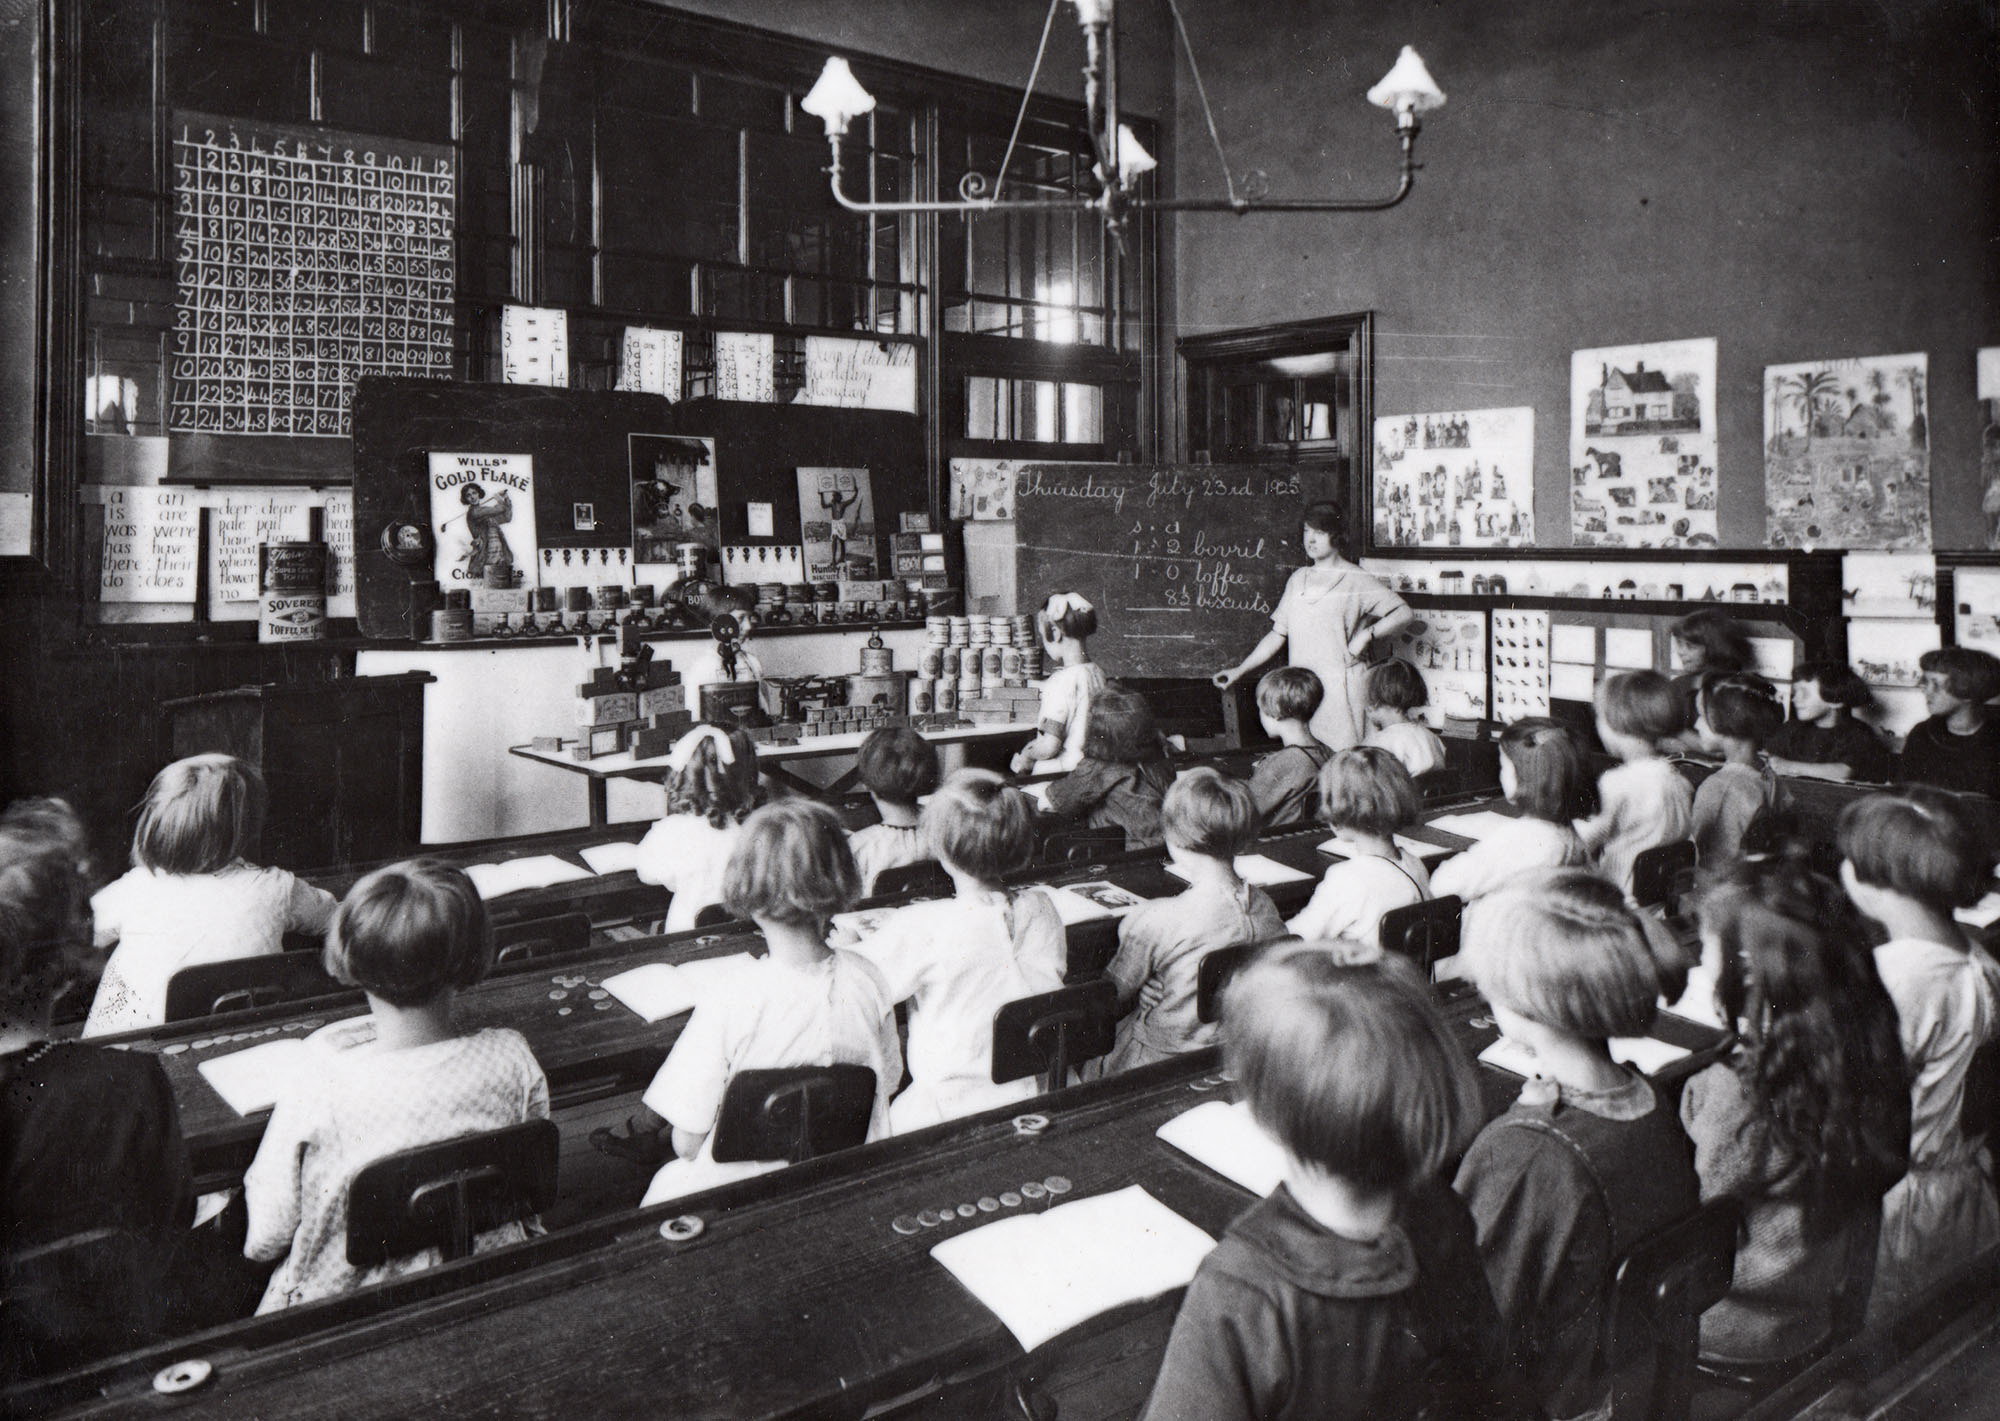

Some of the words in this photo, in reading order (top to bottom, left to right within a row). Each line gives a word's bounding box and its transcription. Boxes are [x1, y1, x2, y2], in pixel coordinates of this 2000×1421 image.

[205, 130, 218, 148] 2
[229, 132, 240, 151] 3
[273, 140, 286, 157] 5
[318, 146, 334, 163] 7
[344, 150, 355, 165] 8
[364, 152, 376, 168] 9
[387, 154, 402, 170] 10
[412, 156, 421, 172] 11
[434, 159, 452, 175] 12
[207, 151, 220, 170] 2
[228, 154, 241, 172] 3
[250, 160, 266, 176] 4
[272, 162, 286, 177] 5
[298, 166, 308, 179] 6
[321, 167, 331, 182] 7
[342, 169, 354, 185] 8
[363, 171, 375, 188] 9
[387, 176, 401, 190] 10
[411, 178, 421, 192] 11
[434, 179, 451, 194] 12
[180, 170, 196, 190] 2
[206, 176, 219, 193] 4
[230, 177, 240, 192] 6
[252, 179, 261, 194] 8
[273, 182, 288, 198] 10
[296, 186, 312, 201] 12
[319, 188, 336, 204] 14
[342, 189, 358, 206] 16
[365, 194, 380, 209] 18
[384, 196, 403, 211] 20
[407, 200, 426, 214] 22
[430, 202, 450, 217] 24
[180, 193, 192, 213] 3
[208, 195, 220, 215] 6
[229, 199, 240, 217] 9
[251, 203, 266, 220] 12
[273, 207, 290, 222] 15
[297, 207, 312, 225] 18
[317, 210, 336, 227] 21
[339, 212, 359, 228] 24
[362, 215, 380, 230] 27
[386, 217, 404, 232] 30
[430, 220, 451, 237] 36
[180, 218, 196, 238] 4
[208, 219, 220, 238] 8
[230, 222, 245, 241] 12
[252, 225, 265, 242] 16
[272, 226, 292, 245] 20
[298, 230, 315, 246] 24
[318, 232, 337, 249] 28
[340, 232, 359, 251] 32
[364, 234, 381, 252] 36
[385, 236, 404, 250] 40
[410, 240, 427, 256] 44
[430, 244, 450, 257] 48
[180, 239, 199, 260] 5
[204, 244, 221, 262] 10
[227, 247, 244, 264] 15
[250, 252, 269, 266] 20
[273, 251, 292, 267] 25
[296, 252, 315, 268] 30
[318, 251, 337, 269] 35
[341, 256, 360, 271] 40
[363, 256, 382, 272] 45
[387, 258, 404, 274] 50
[432, 263, 452, 279] 60
[180, 262, 196, 284] 6
[200, 268, 221, 287] 12
[227, 270, 244, 287] 18
[249, 272, 269, 289] 24
[275, 273, 292, 290] 30
[318, 276, 338, 292] 42
[341, 277, 359, 291] 48
[365, 277, 382, 294] 54
[386, 280, 404, 296] 60
[408, 282, 425, 298] 66
[432, 285, 452, 300] 72
[180, 289, 193, 305] 7
[201, 290, 222, 309] 14
[228, 293, 244, 309] 21
[249, 295, 268, 312] 28
[274, 296, 290, 312] 35
[295, 297, 312, 312] 42
[318, 299, 338, 313] 49
[342, 300, 360, 314] 56
[363, 296, 381, 313] 63
[388, 301, 405, 316] 70
[411, 303, 428, 318] 77
[434, 308, 452, 322] 84
[111, 491, 123, 504] a
[158, 494, 184, 505] an
[1018, 470, 1125, 513] Thursday
[1146, 472, 1195, 509] July
[1265, 479, 1300, 495] 1925
[110, 504, 124, 520] is
[104, 524, 137, 537] was
[154, 526, 195, 538] were
[104, 536, 131, 553] has
[1191, 530, 1265, 559] bovril
[1194, 561, 1250, 597] toffee
[1196, 583, 1270, 614] biscuits
